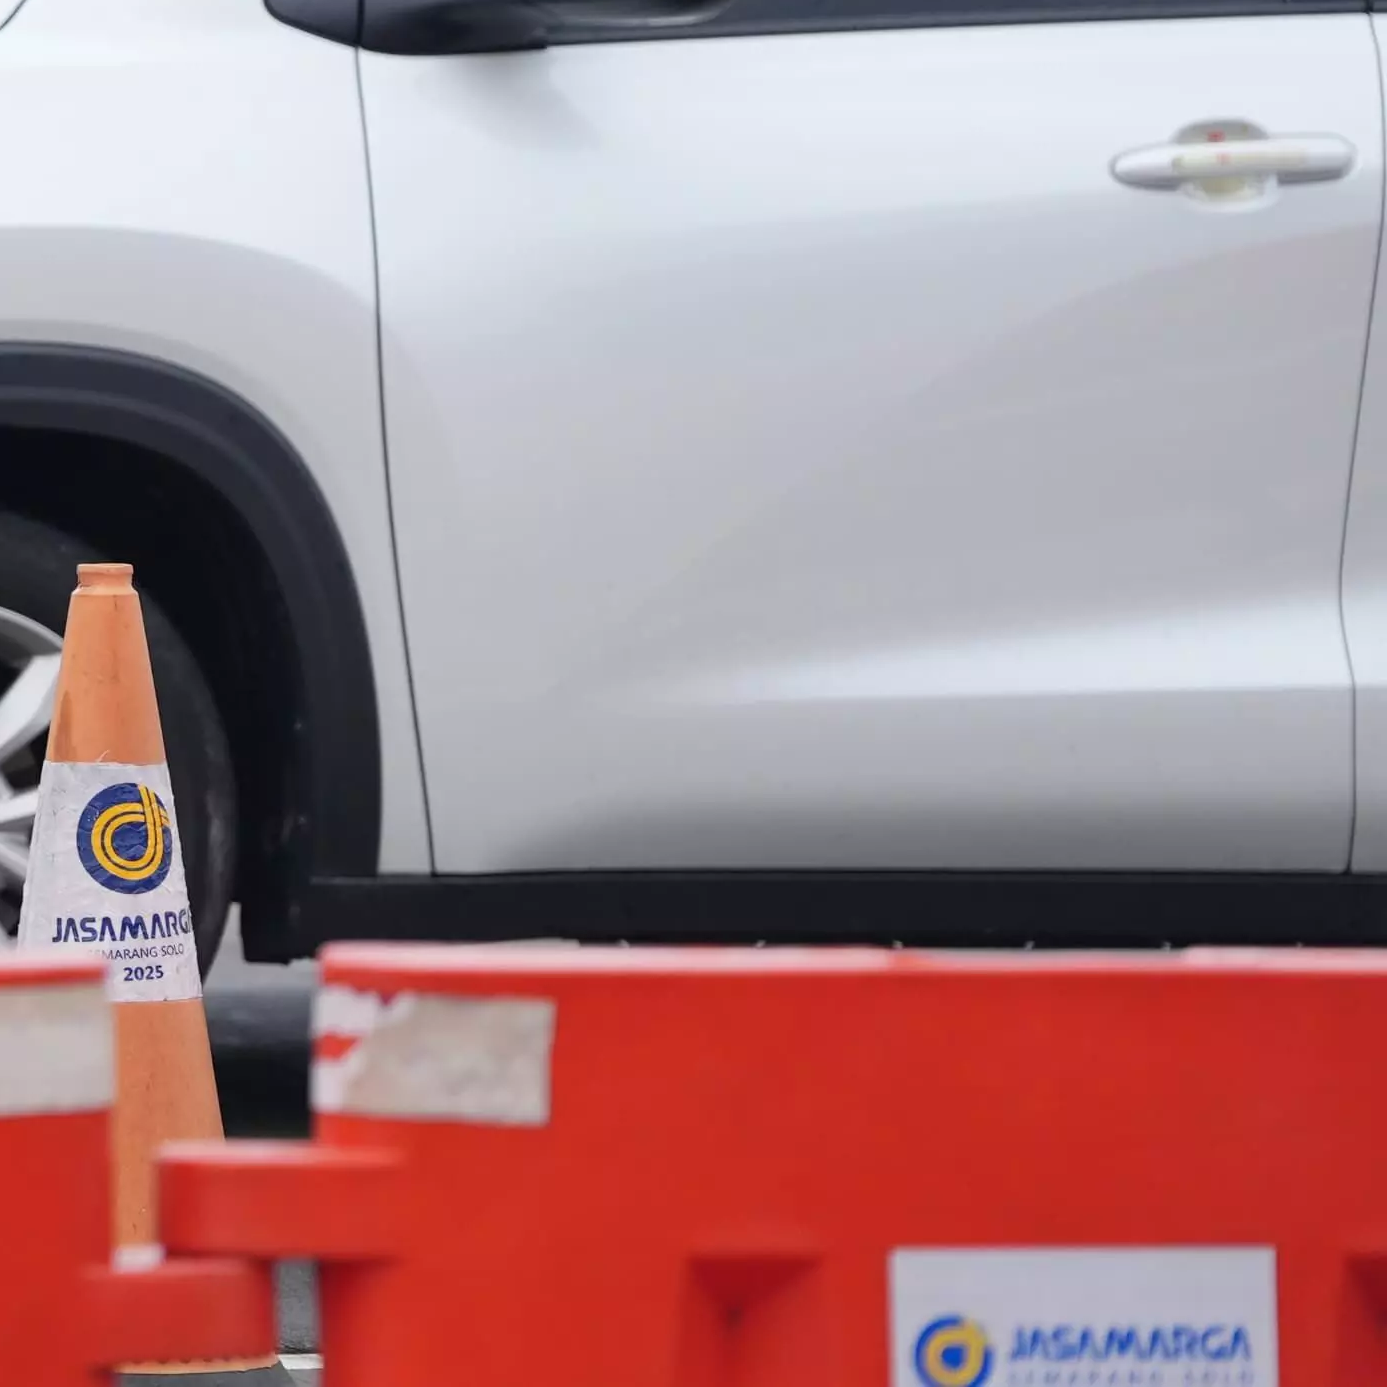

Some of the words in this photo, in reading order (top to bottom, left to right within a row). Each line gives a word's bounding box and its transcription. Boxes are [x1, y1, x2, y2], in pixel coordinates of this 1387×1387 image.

[161, 942, 184, 957] SOLO
[123, 964, 164, 982] 2025
[1011, 1326, 1251, 1363] JASAMARGA
